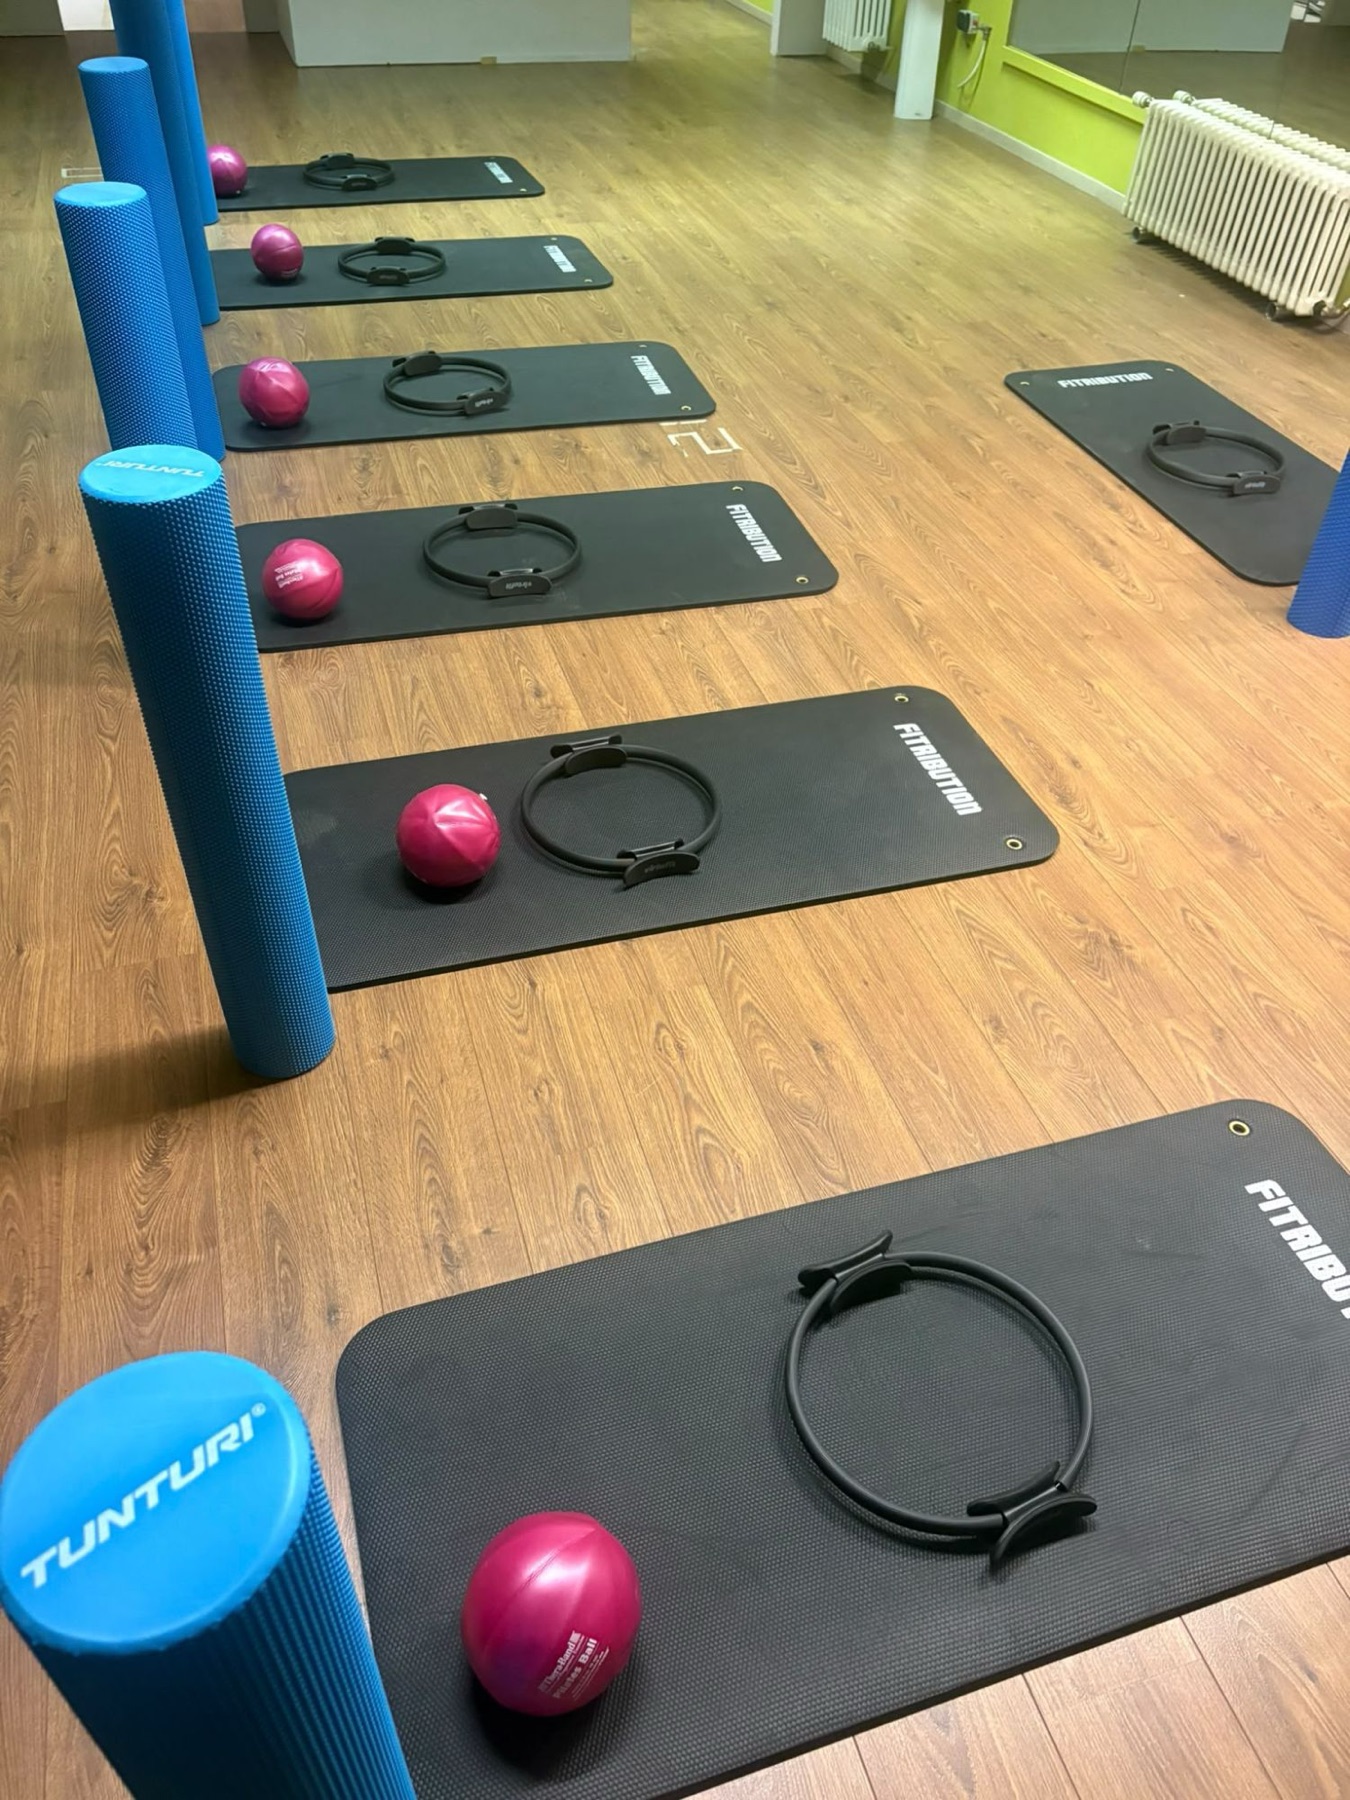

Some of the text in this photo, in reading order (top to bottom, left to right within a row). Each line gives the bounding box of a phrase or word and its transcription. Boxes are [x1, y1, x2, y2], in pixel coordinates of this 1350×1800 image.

[726, 503, 782, 562] FITRIBUTION
[893, 723, 983, 815] FITRIBUTION
[1244, 1179, 1350, 1319] FITRIBU
[578, 1638, 597, 1664] Ball
